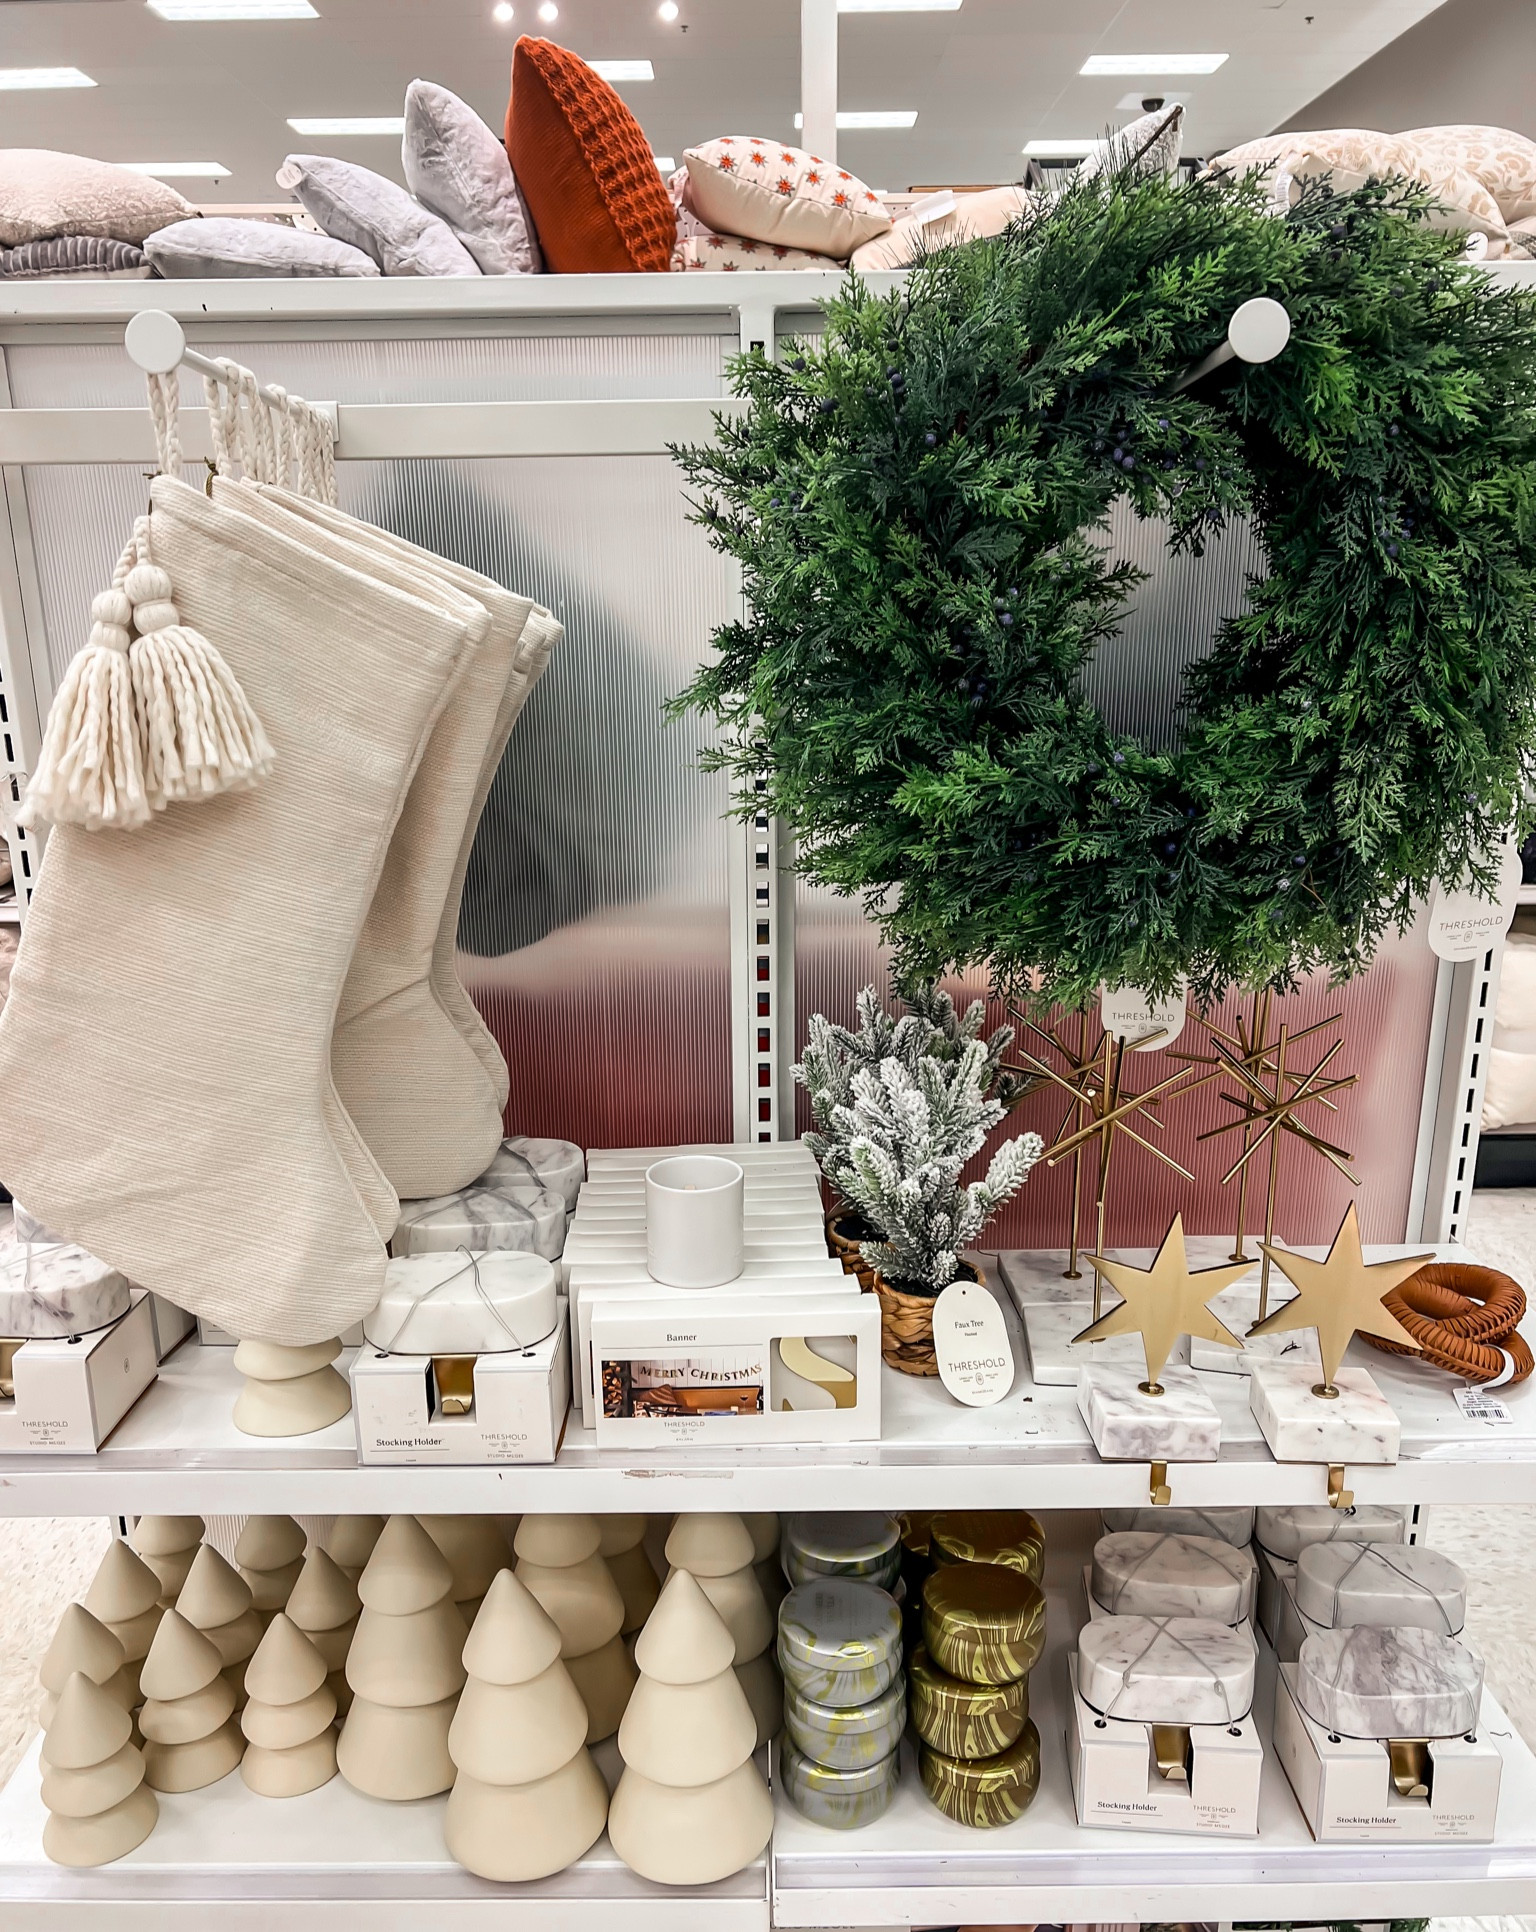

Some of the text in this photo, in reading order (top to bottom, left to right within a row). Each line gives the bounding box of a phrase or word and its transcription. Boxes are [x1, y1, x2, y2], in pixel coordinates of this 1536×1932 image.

[1440, 916, 1503, 931] THRESHOLD
[1112, 1012, 1175, 1022] THRESHOLD
[970, 1319, 984, 1327] Tree
[666, 1333, 697, 1341] Banner
[948, 1357, 1006, 1372] THRESHOLD
[640, 1363, 762, 1381] MERRY CHRISTMAS
[481, 1433, 528, 1441] THRESHOLD
[376, 1438, 442, 1447] Stocking Holder
[1097, 1801, 1158, 1812] Stocking Holder
[1193, 1805, 1237, 1814] THRESHOLD
[1336, 1816, 1397, 1825] Stocking Holder
